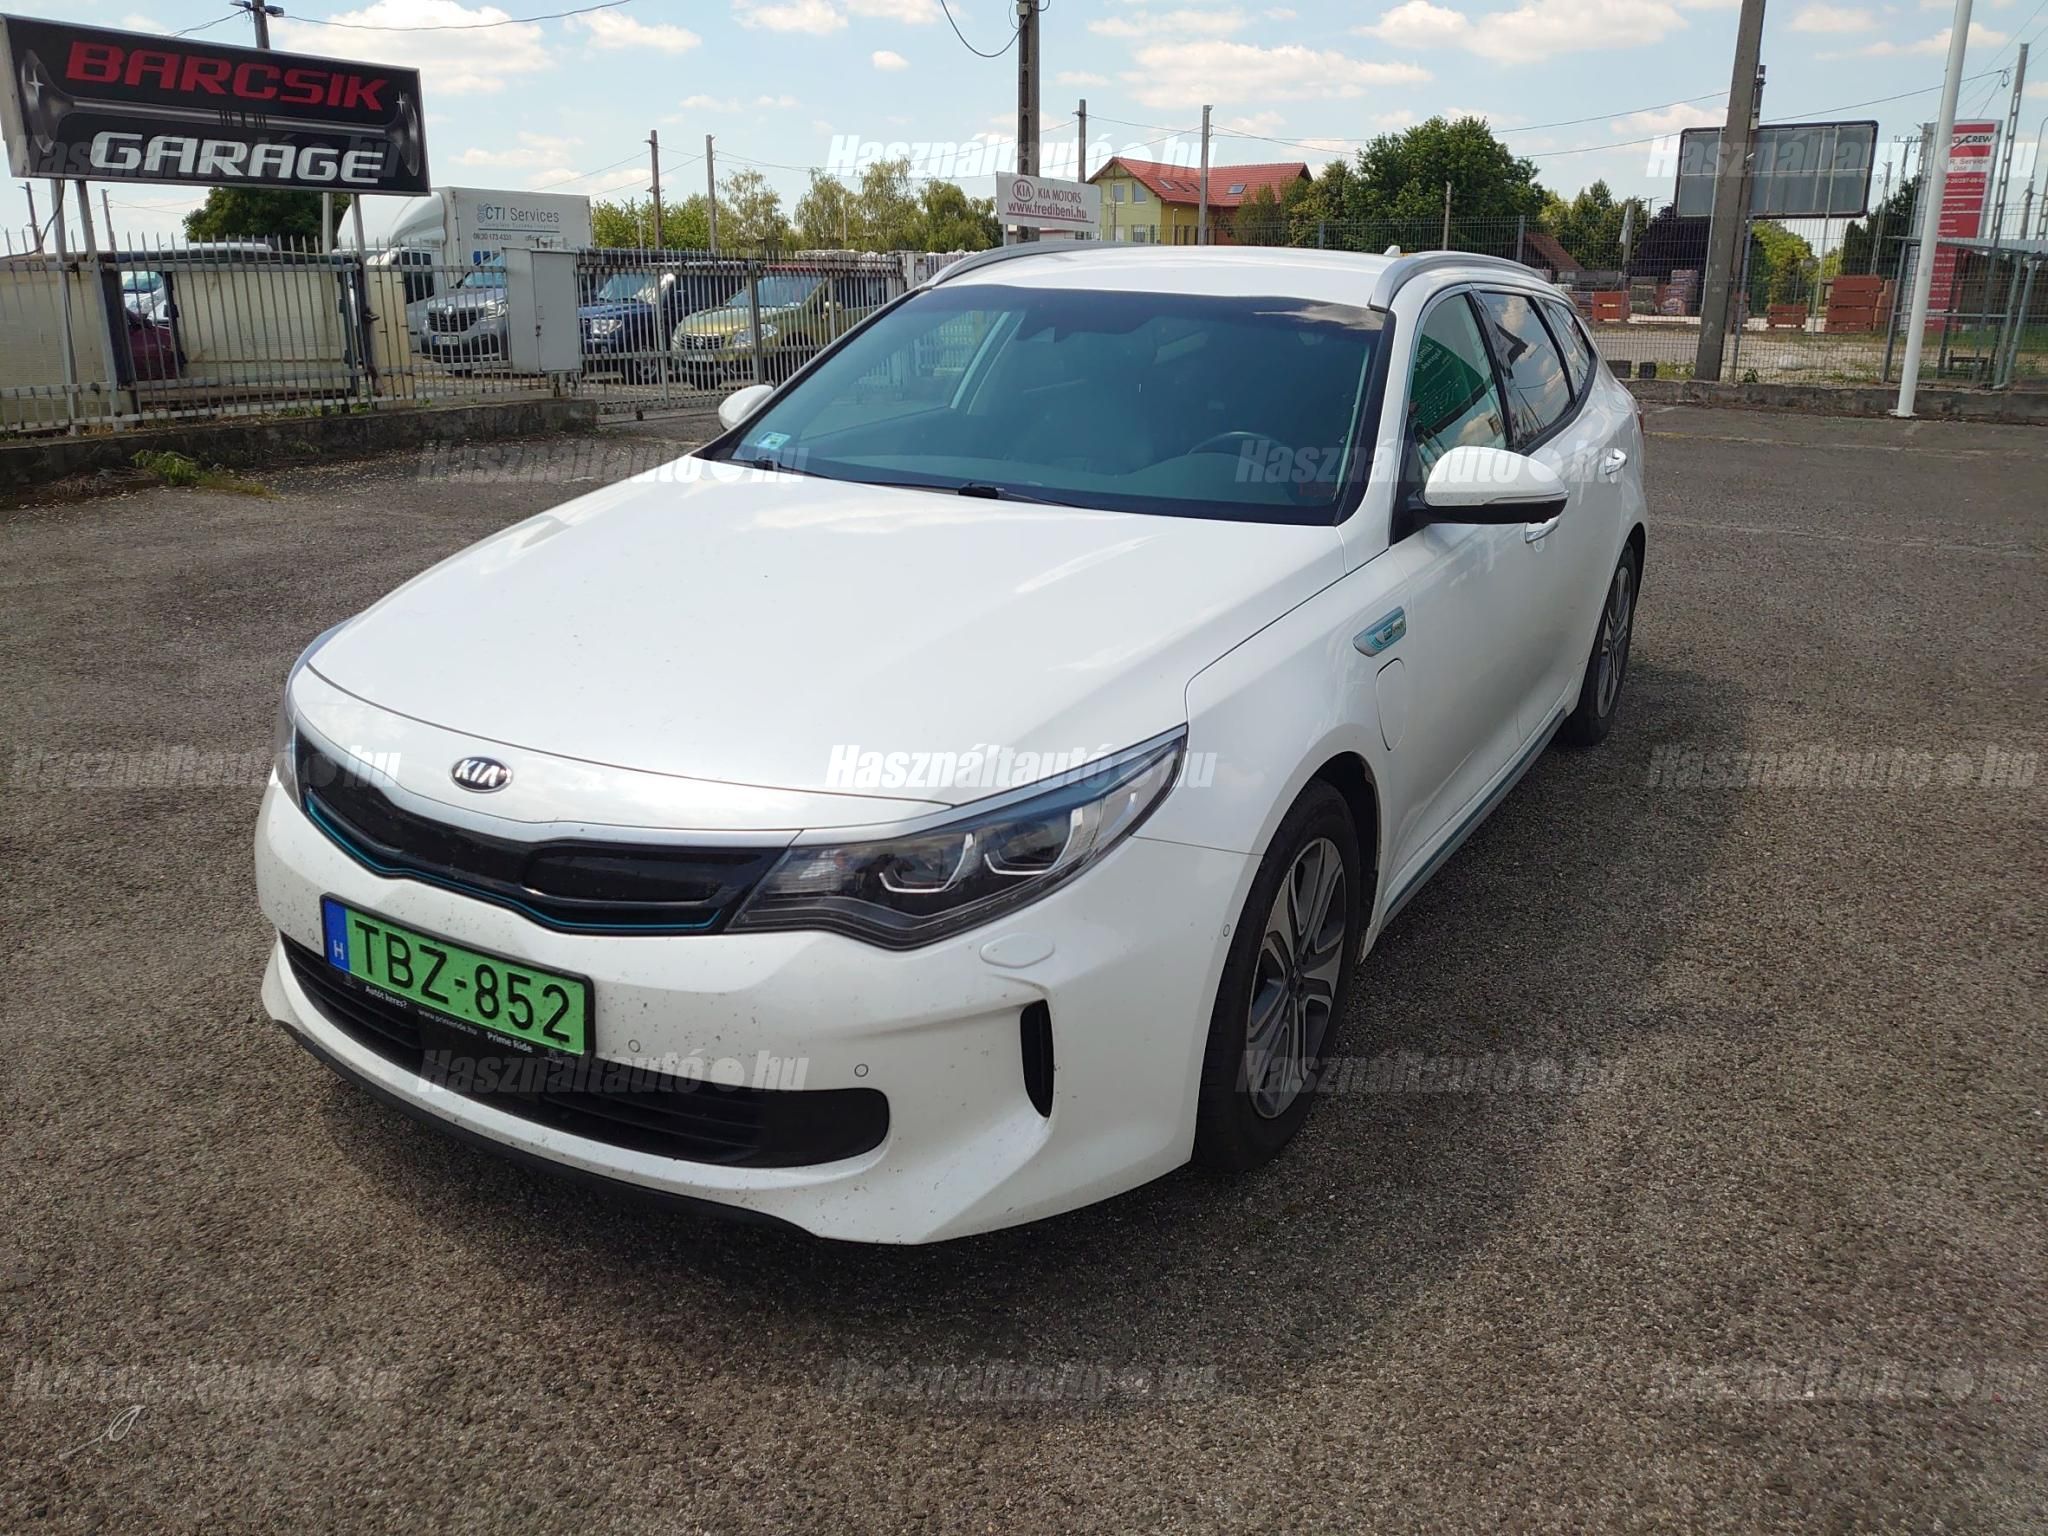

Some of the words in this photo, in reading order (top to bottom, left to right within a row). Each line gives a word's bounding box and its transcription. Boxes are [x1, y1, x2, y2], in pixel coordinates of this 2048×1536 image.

[66, 41, 389, 111] BARCSIK
[90, 131, 384, 183] GARAGE
[1016, 183, 1031, 197] KIA
[1038, 187, 1050, 200] KIA
[1052, 189, 1082, 203] MOTORS
[486, 206, 505, 220] CTI
[510, 207, 560, 222] Services
[1008, 201, 1087, 219] www.fredibeni.hu
[455, 759, 500, 788] KIA
[333, 939, 344, 961] H
[354, 919, 570, 1044] TBZ-852
[486, 1031, 512, 1047] Prime
